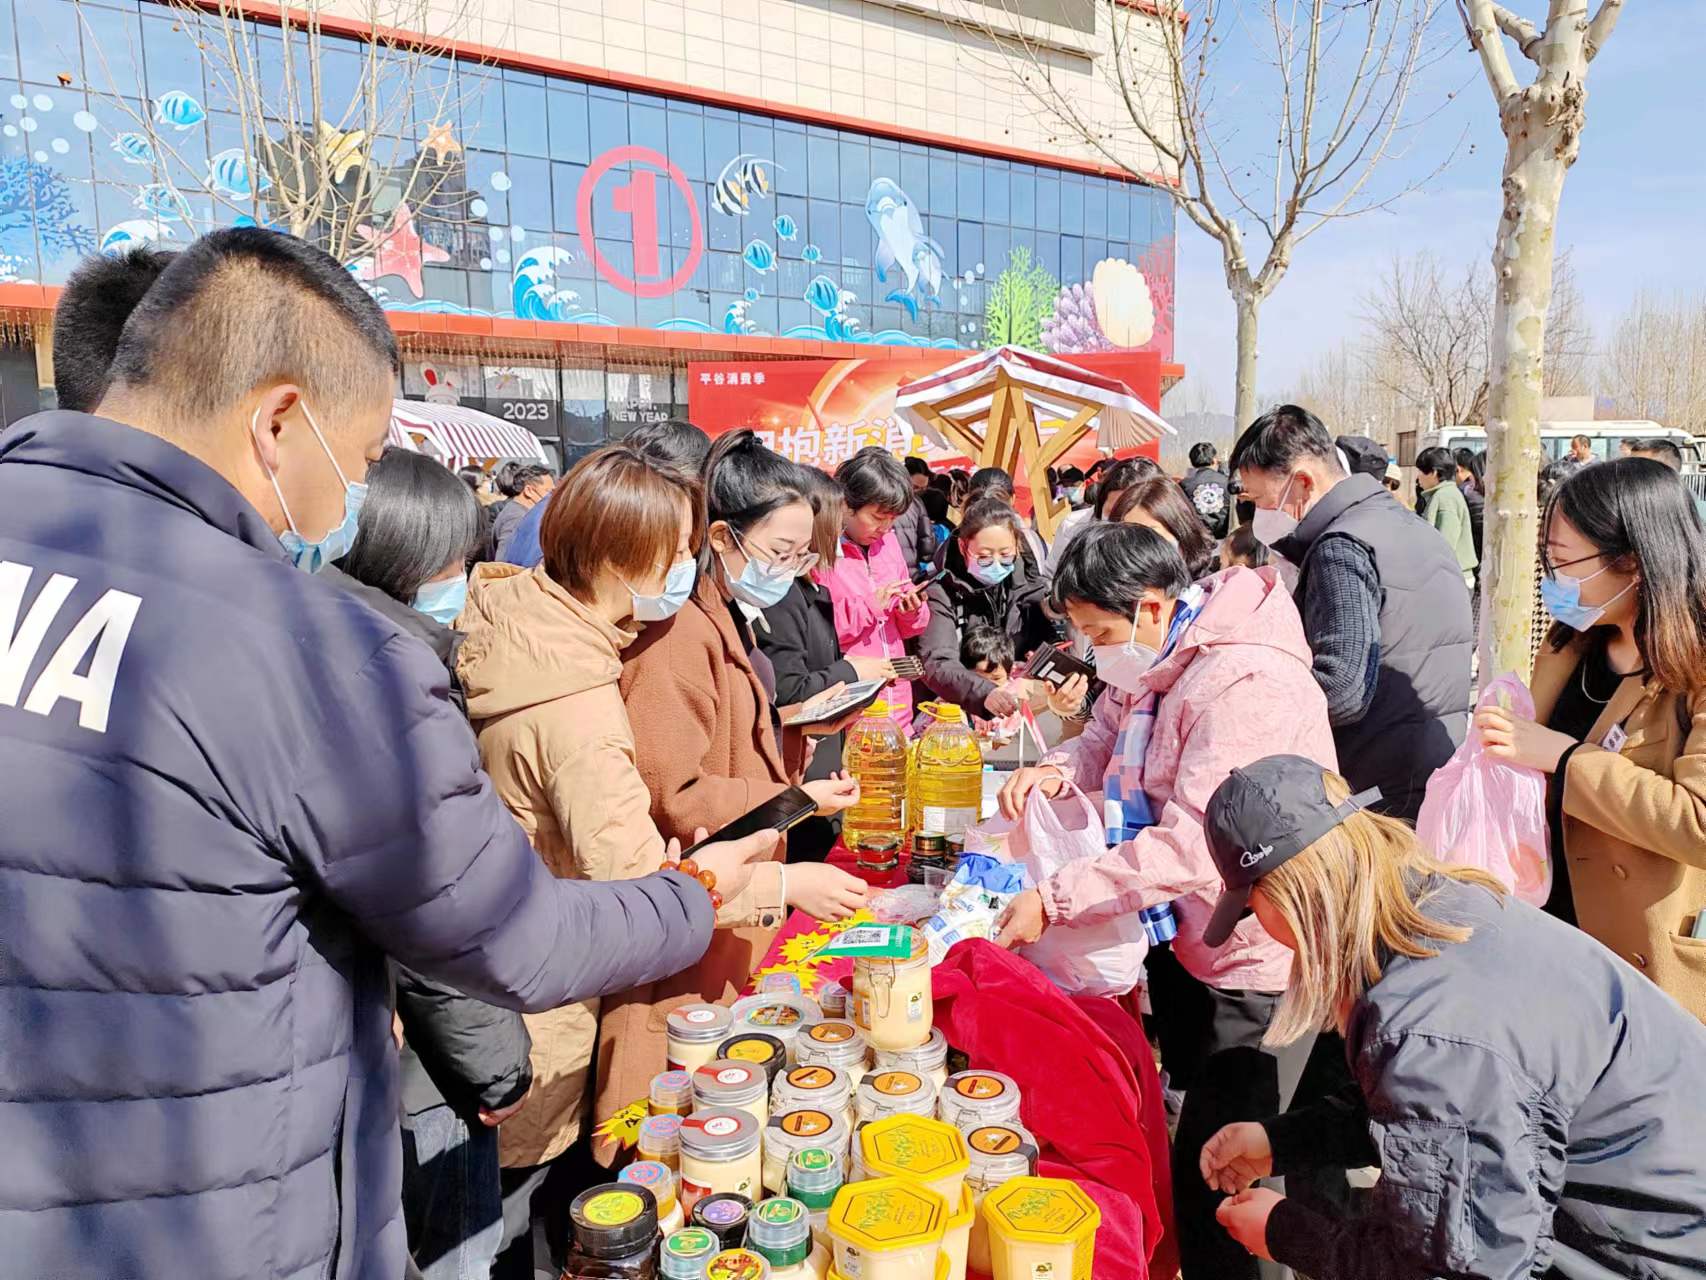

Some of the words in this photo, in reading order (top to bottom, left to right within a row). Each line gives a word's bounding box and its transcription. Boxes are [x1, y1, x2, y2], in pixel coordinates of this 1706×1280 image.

[699, 371, 766, 385] 平谷消费季
[503, 402, 549, 420] 2023
[612, 411, 636, 422] NEW
